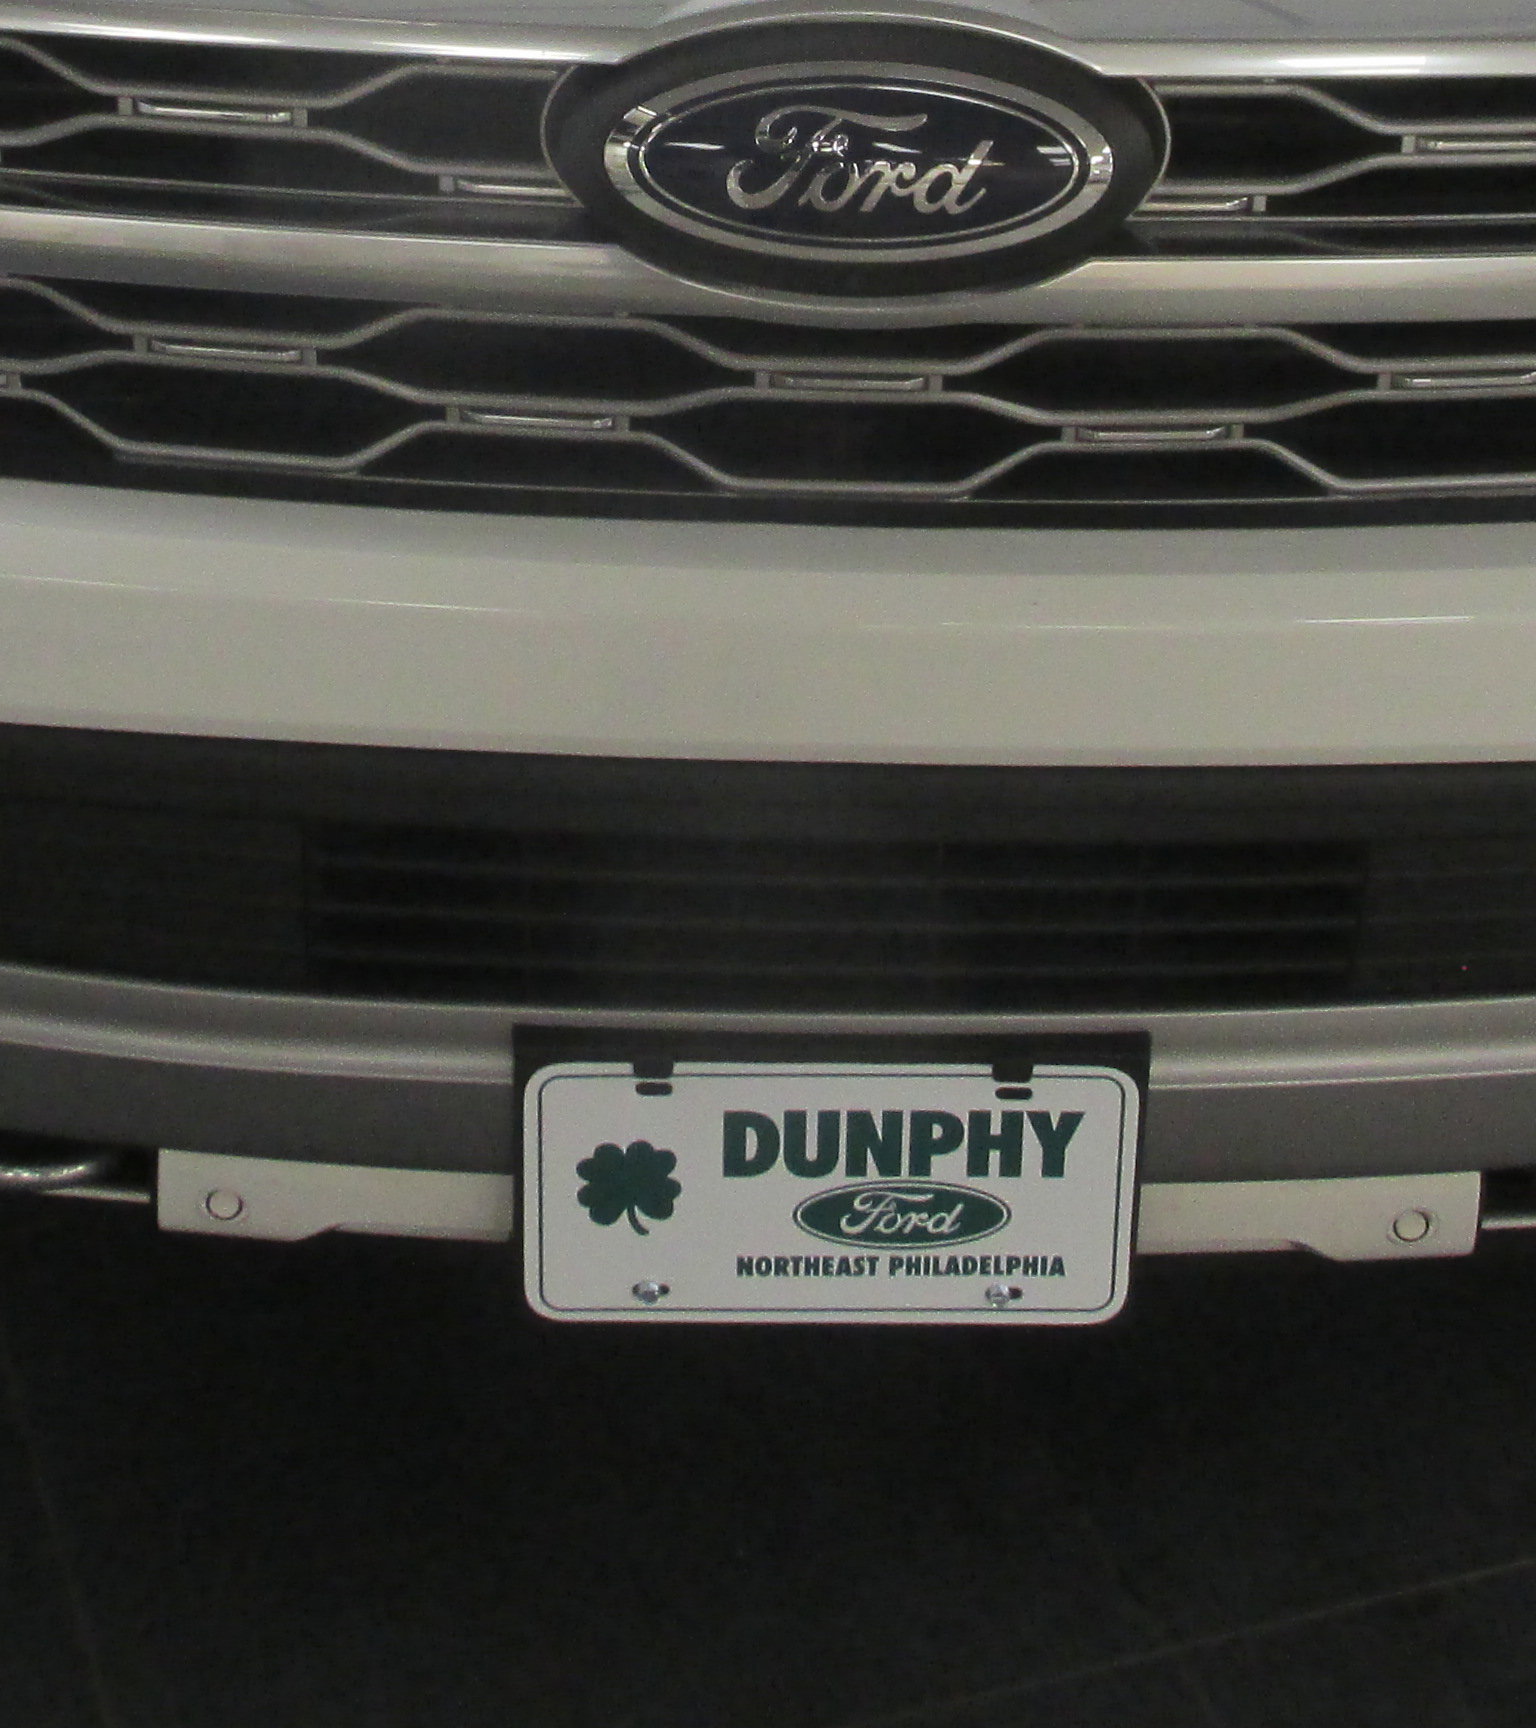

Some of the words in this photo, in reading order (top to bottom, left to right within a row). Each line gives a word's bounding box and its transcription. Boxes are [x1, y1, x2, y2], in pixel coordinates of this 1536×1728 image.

[726, 104, 994, 215] Ford
[722, 1108, 1087, 1179] DUNPHY
[839, 1190, 965, 1236] Ford
[735, 1255, 880, 1278] NORTHEAST
[888, 1255, 1067, 1278] PHILADELPHIA
